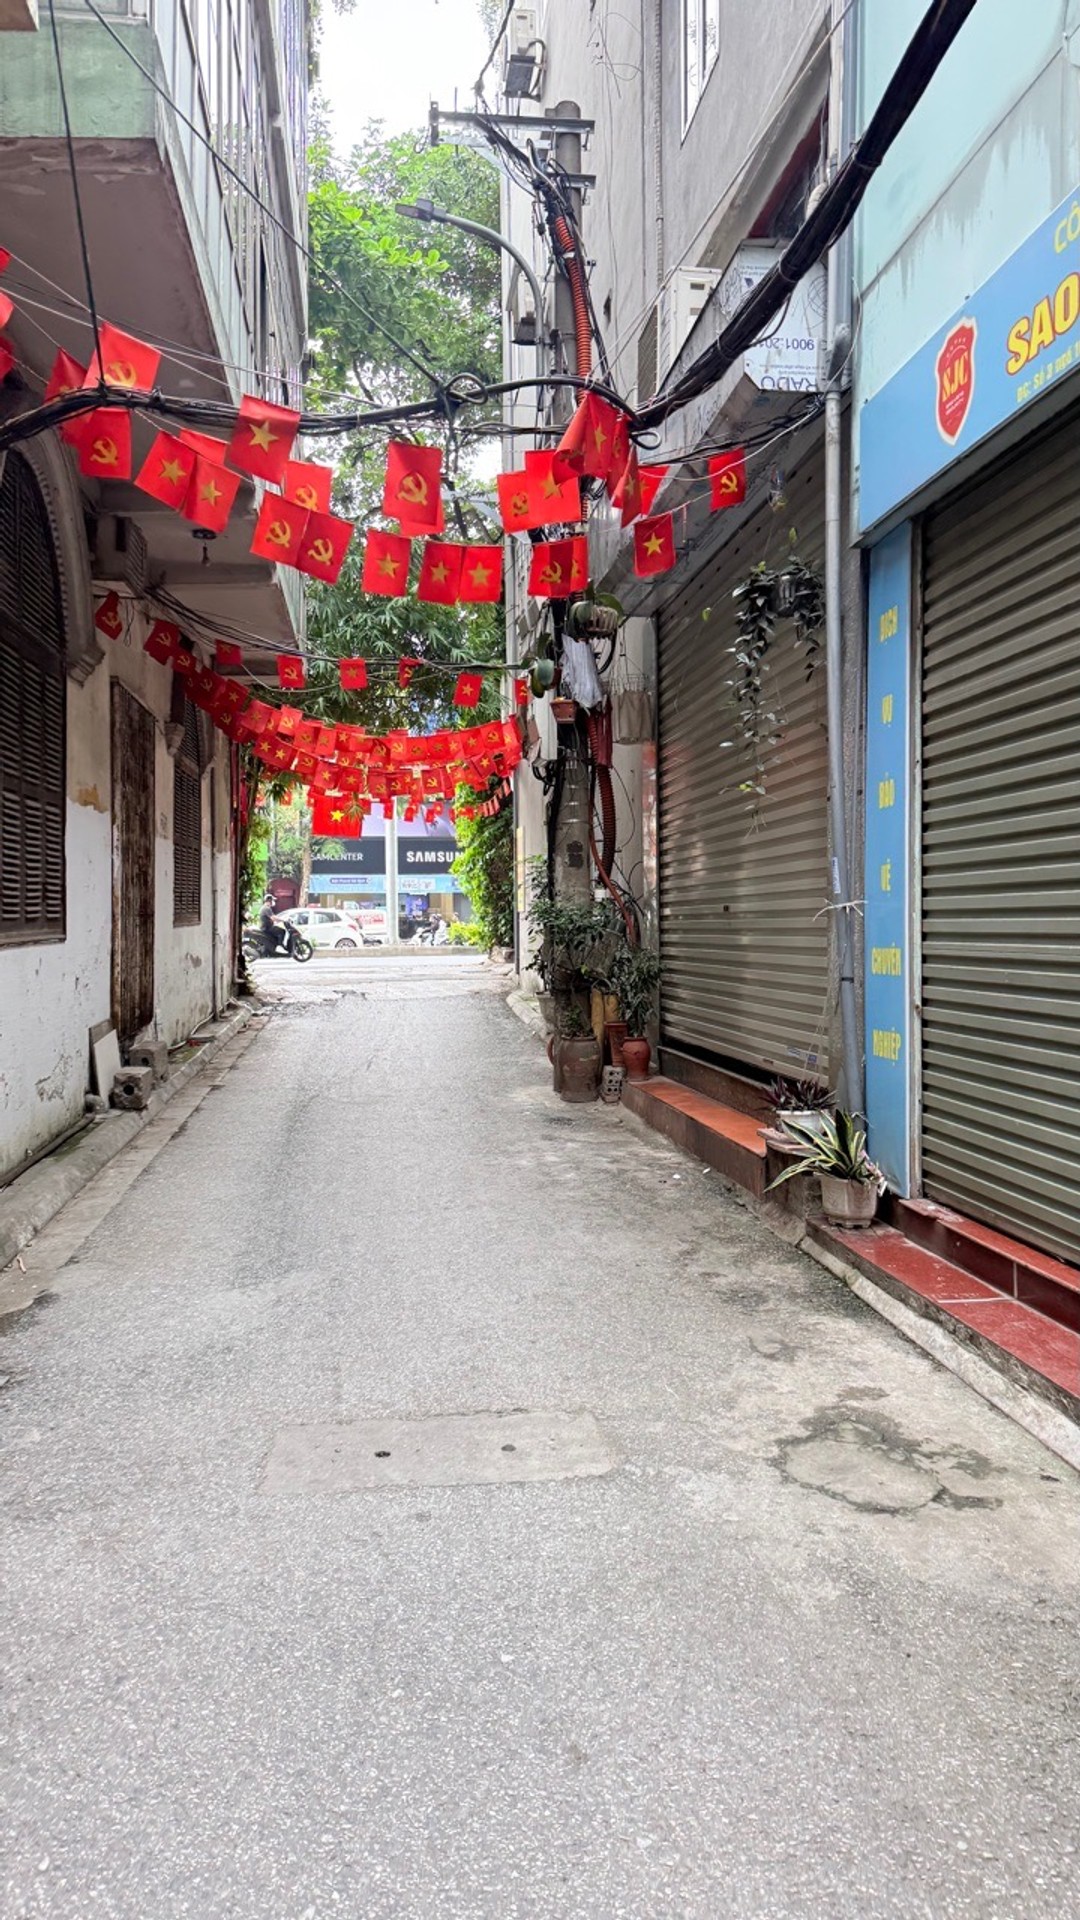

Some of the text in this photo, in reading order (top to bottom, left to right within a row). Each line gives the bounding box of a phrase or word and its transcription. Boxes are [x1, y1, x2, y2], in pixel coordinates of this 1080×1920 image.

[1006, 271, 1080, 376] SAO
[942, 351, 969, 402] SJC
[871, 941, 902, 976] CHUYÊN
[872, 1027, 902, 1067] NGHIỆP
